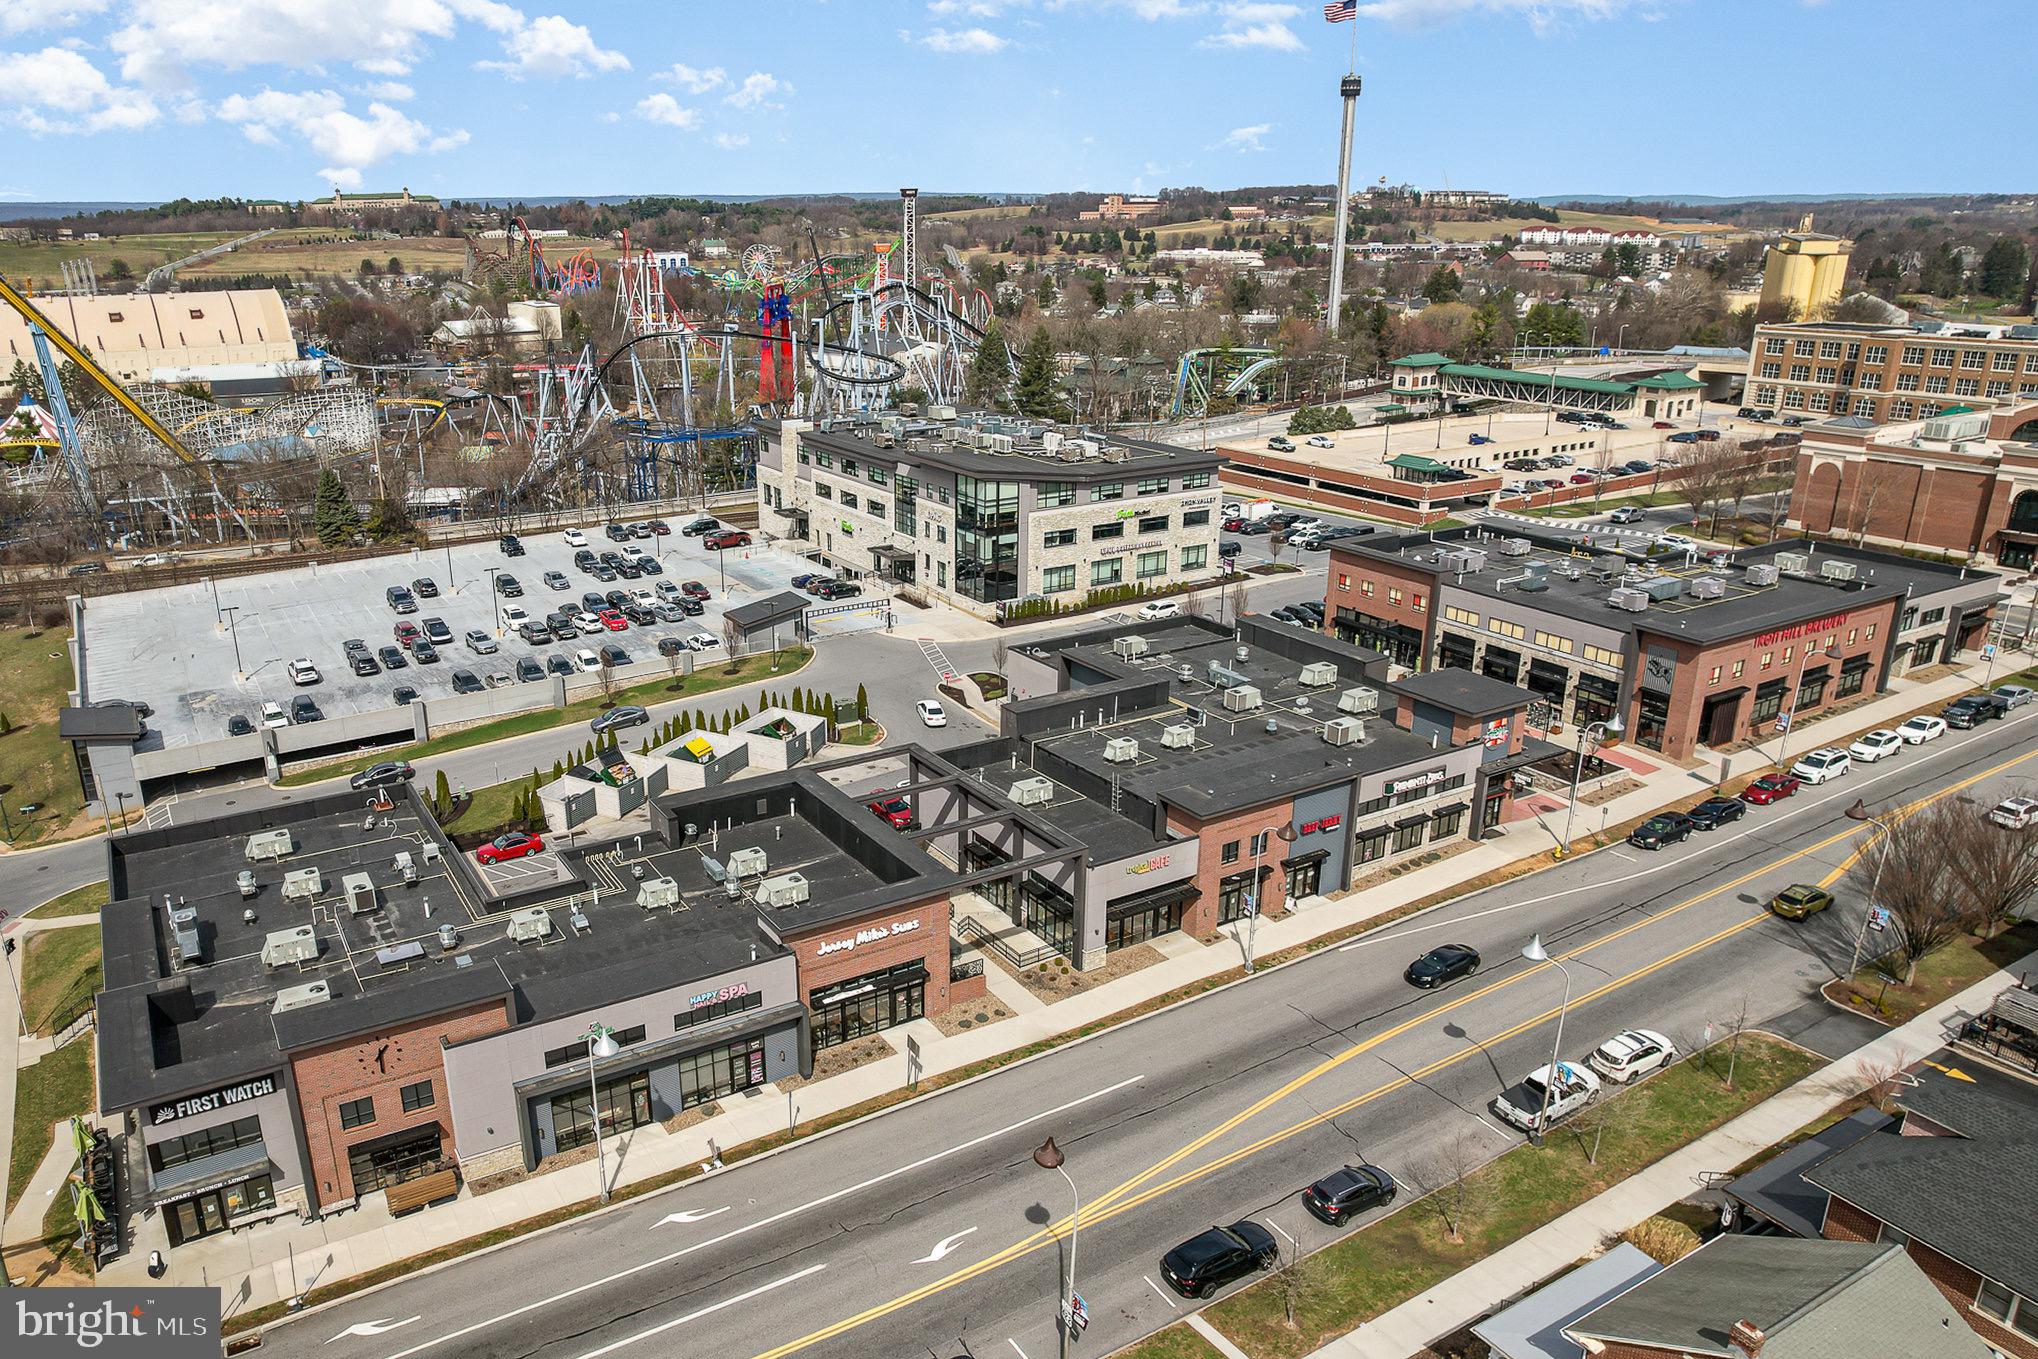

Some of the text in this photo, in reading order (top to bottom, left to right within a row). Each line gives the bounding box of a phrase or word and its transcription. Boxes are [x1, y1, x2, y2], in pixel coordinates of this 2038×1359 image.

[1781, 624, 1805, 641] HILL
[1805, 613, 1851, 635] BREWERY
[1149, 855, 1170, 871] CAFE
[816, 938, 855, 956] Jersey
[688, 983, 749, 1005] HAPPY SPA
[176, 1078, 274, 1118] FIRST WATCH
[153, 1173, 250, 1207] BREAKFAST BRUNCH LUNCH
